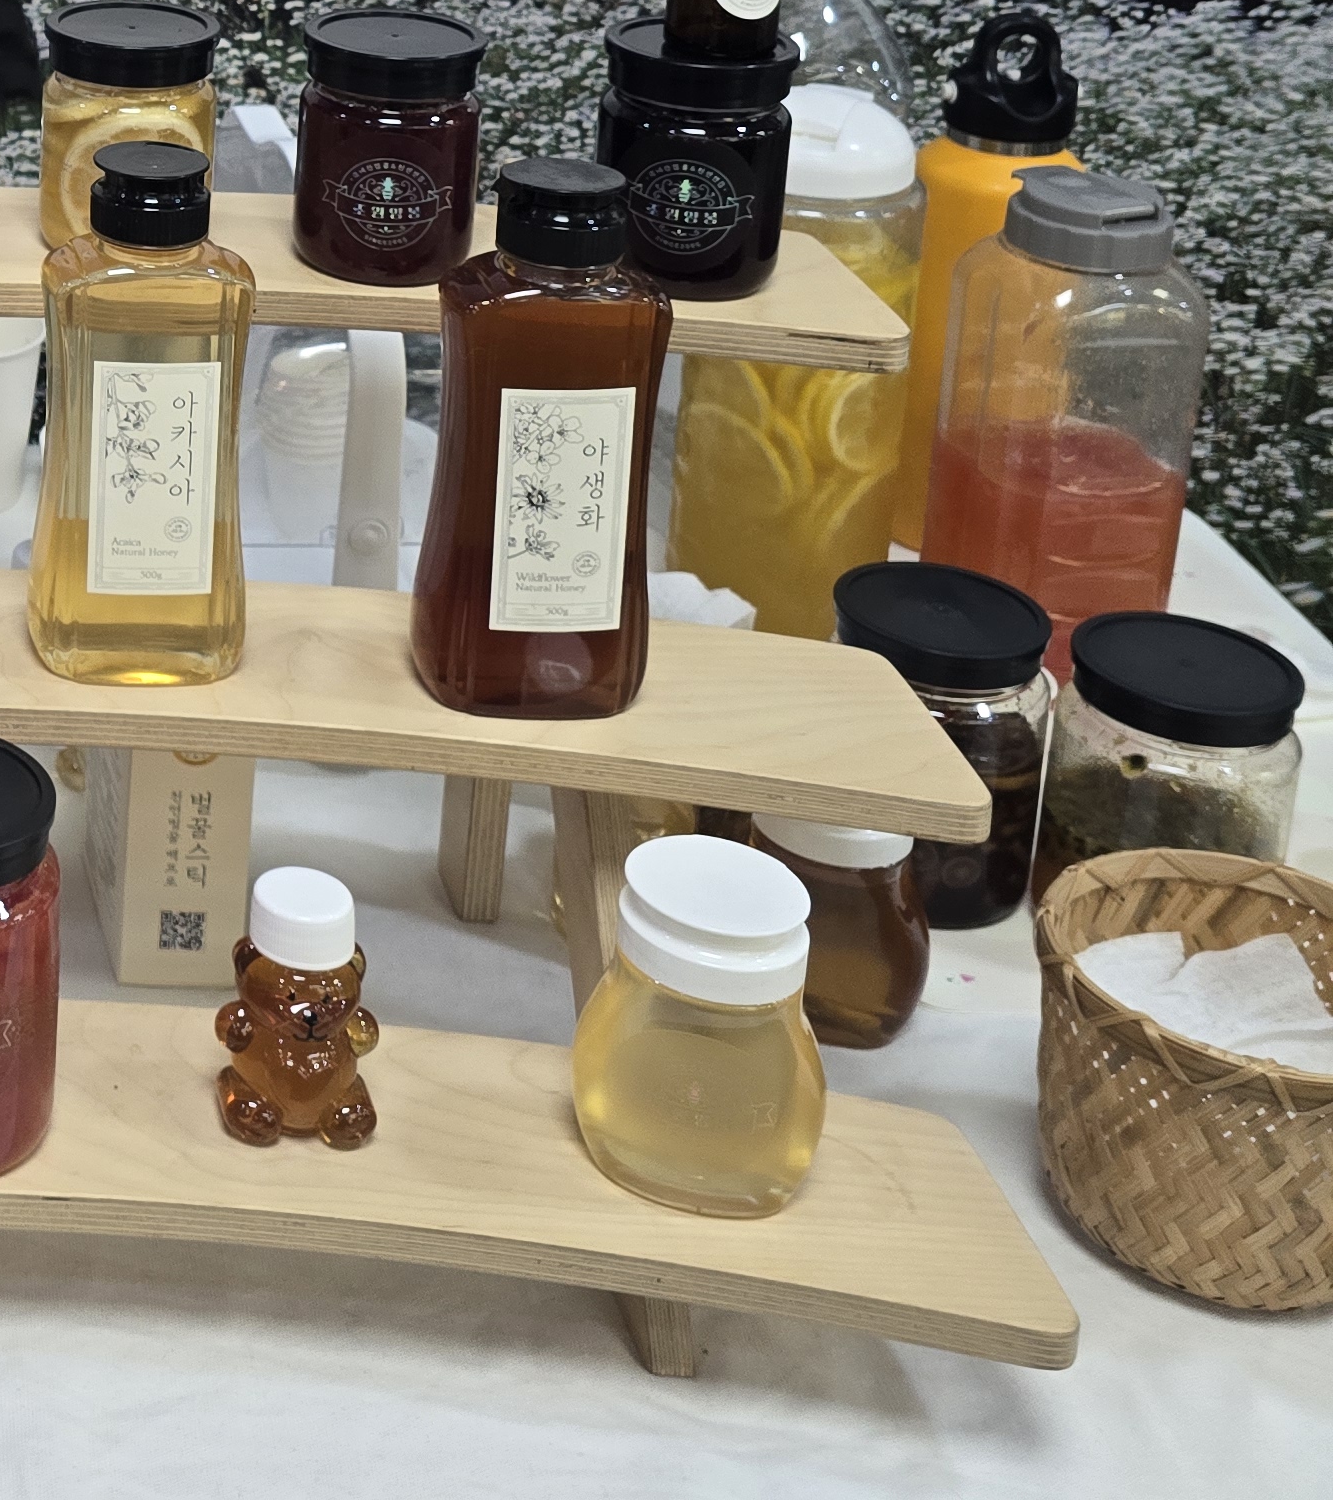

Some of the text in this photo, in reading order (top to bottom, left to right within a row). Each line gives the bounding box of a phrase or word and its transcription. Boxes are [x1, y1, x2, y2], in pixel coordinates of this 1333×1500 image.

[167, 390, 199, 507] 아카시아
[575, 436, 610, 535] 야생화
[111, 547, 179, 559] Natural Honey
[515, 571, 572, 583] Wildflower
[515, 582, 587, 595] Natural Honey
[185, 789, 213, 890] 벌꿀스틱
